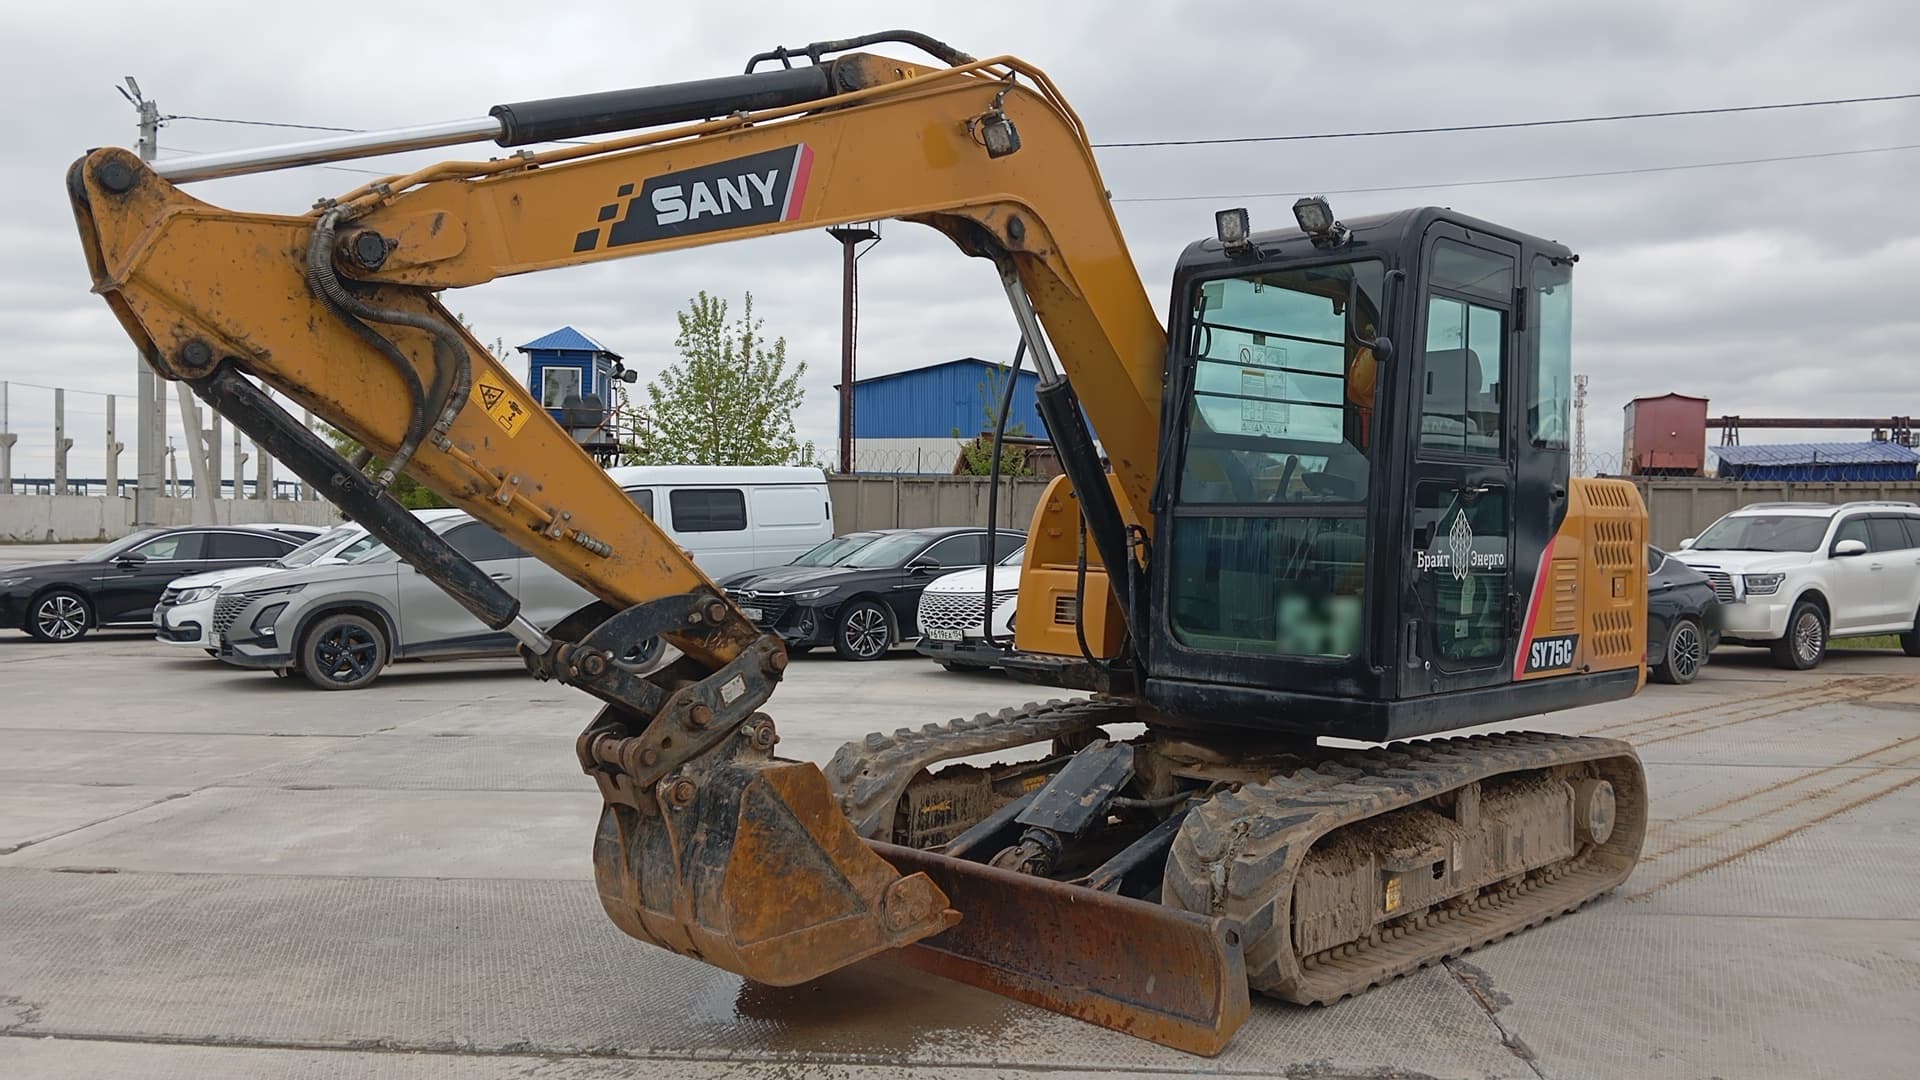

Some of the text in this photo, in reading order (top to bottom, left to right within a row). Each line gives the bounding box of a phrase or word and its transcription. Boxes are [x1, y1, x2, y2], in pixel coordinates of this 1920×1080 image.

[651, 169, 778, 225] SANY
[1417, 550, 1504, 572] Брайт Энерго
[1531, 639, 1572, 668] SY75C
